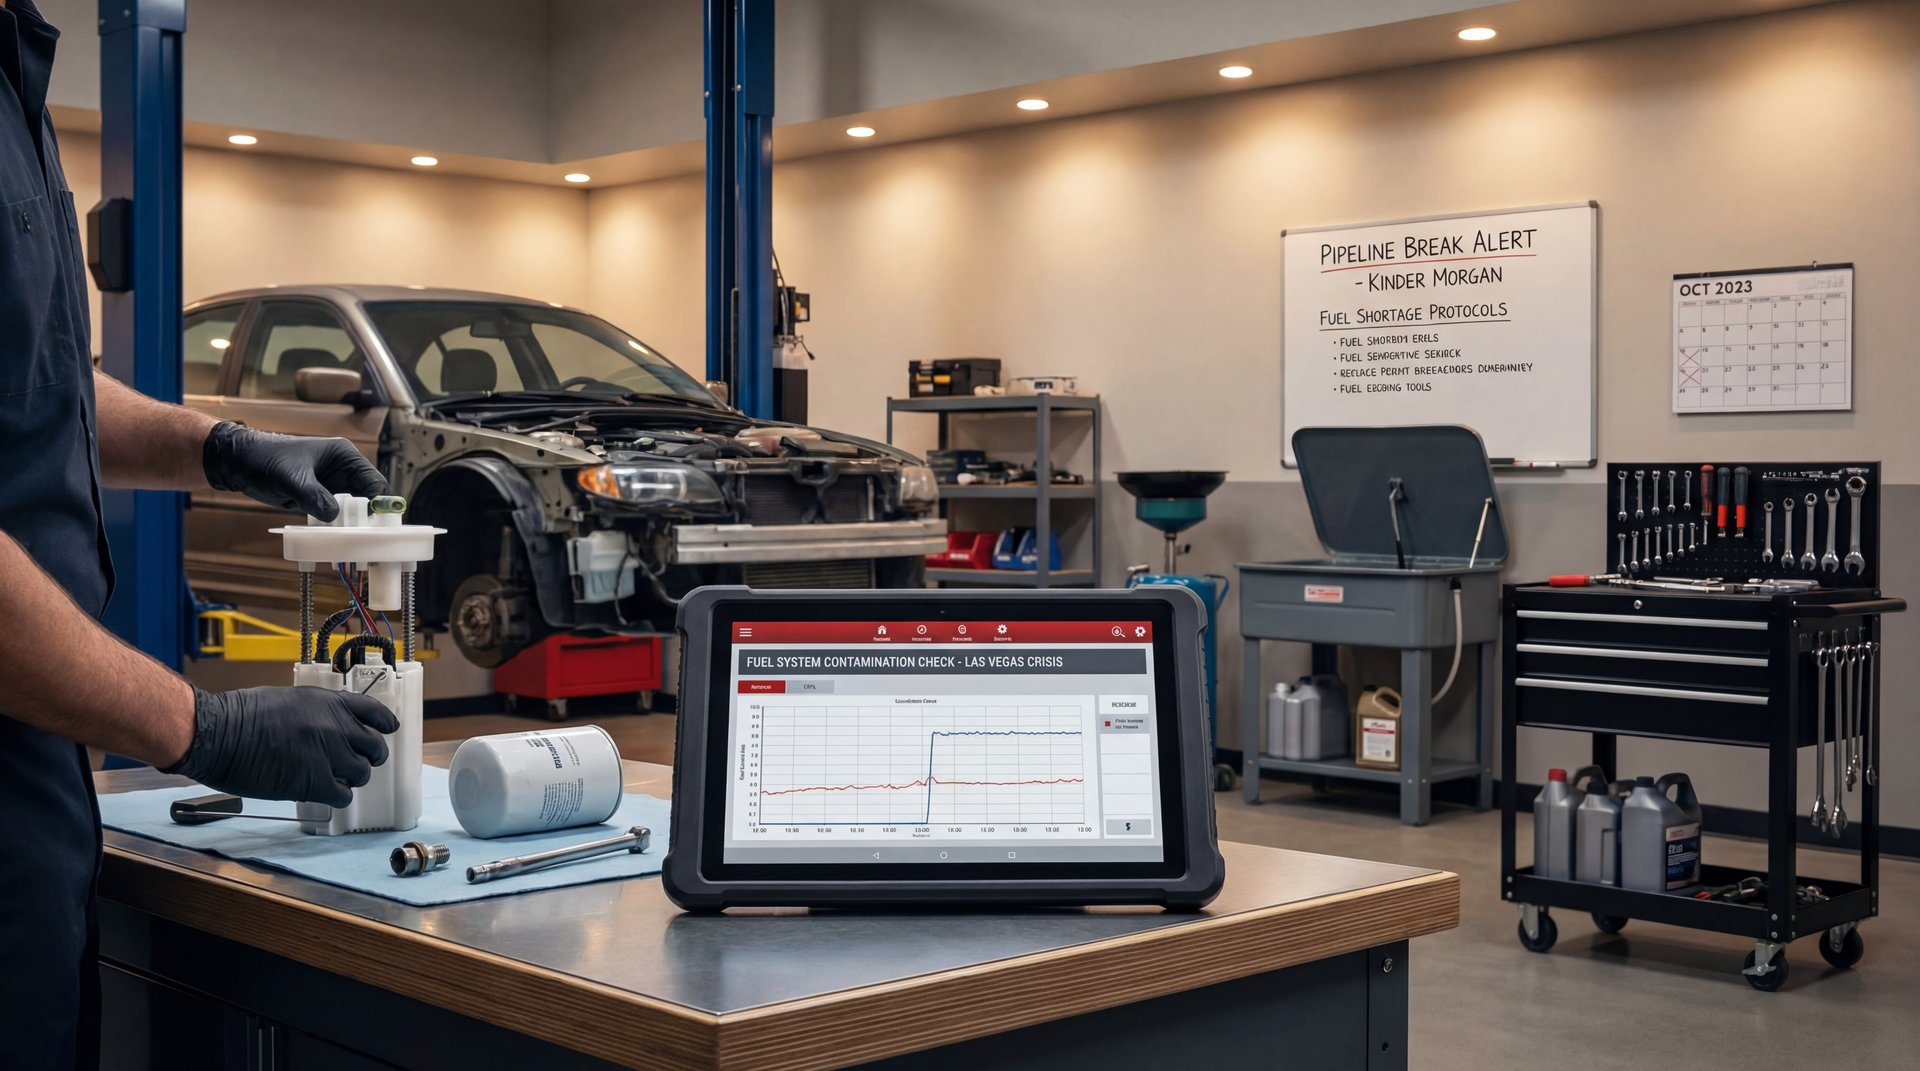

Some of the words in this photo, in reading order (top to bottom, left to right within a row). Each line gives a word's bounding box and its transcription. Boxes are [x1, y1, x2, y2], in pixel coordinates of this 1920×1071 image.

[1321, 241, 1395, 265] PIPELINE
[1404, 235, 1464, 259] BREAK
[1473, 229, 1537, 253] ALERT
[1369, 272, 1425, 292] KINDER
[1433, 266, 1502, 287] MORGAN
[1680, 283, 1710, 296] OCT
[1715, 280, 1753, 295] 2023
[1320, 310, 1350, 326] FUEL
[1357, 307, 1422, 324] SHORTAGE
[1429, 302, 1508, 320] PROTOCOLS
[1340, 337, 1363, 347] FUEL
[1340, 353, 1363, 363] FUEL
[1340, 384, 1362, 394] FUEL
[1406, 382, 1432, 392] TOOLS
[746, 656, 774, 668] FUEL
[776, 656, 821, 668] SYSTEM
[824, 656, 915, 668] CONTAMINATION
[918, 656, 955, 668] CHECK
[965, 656, 986, 668] LAS
[988, 656, 1025, 668] VEGAS
[1027, 656, 1063, 668] CRISIS
